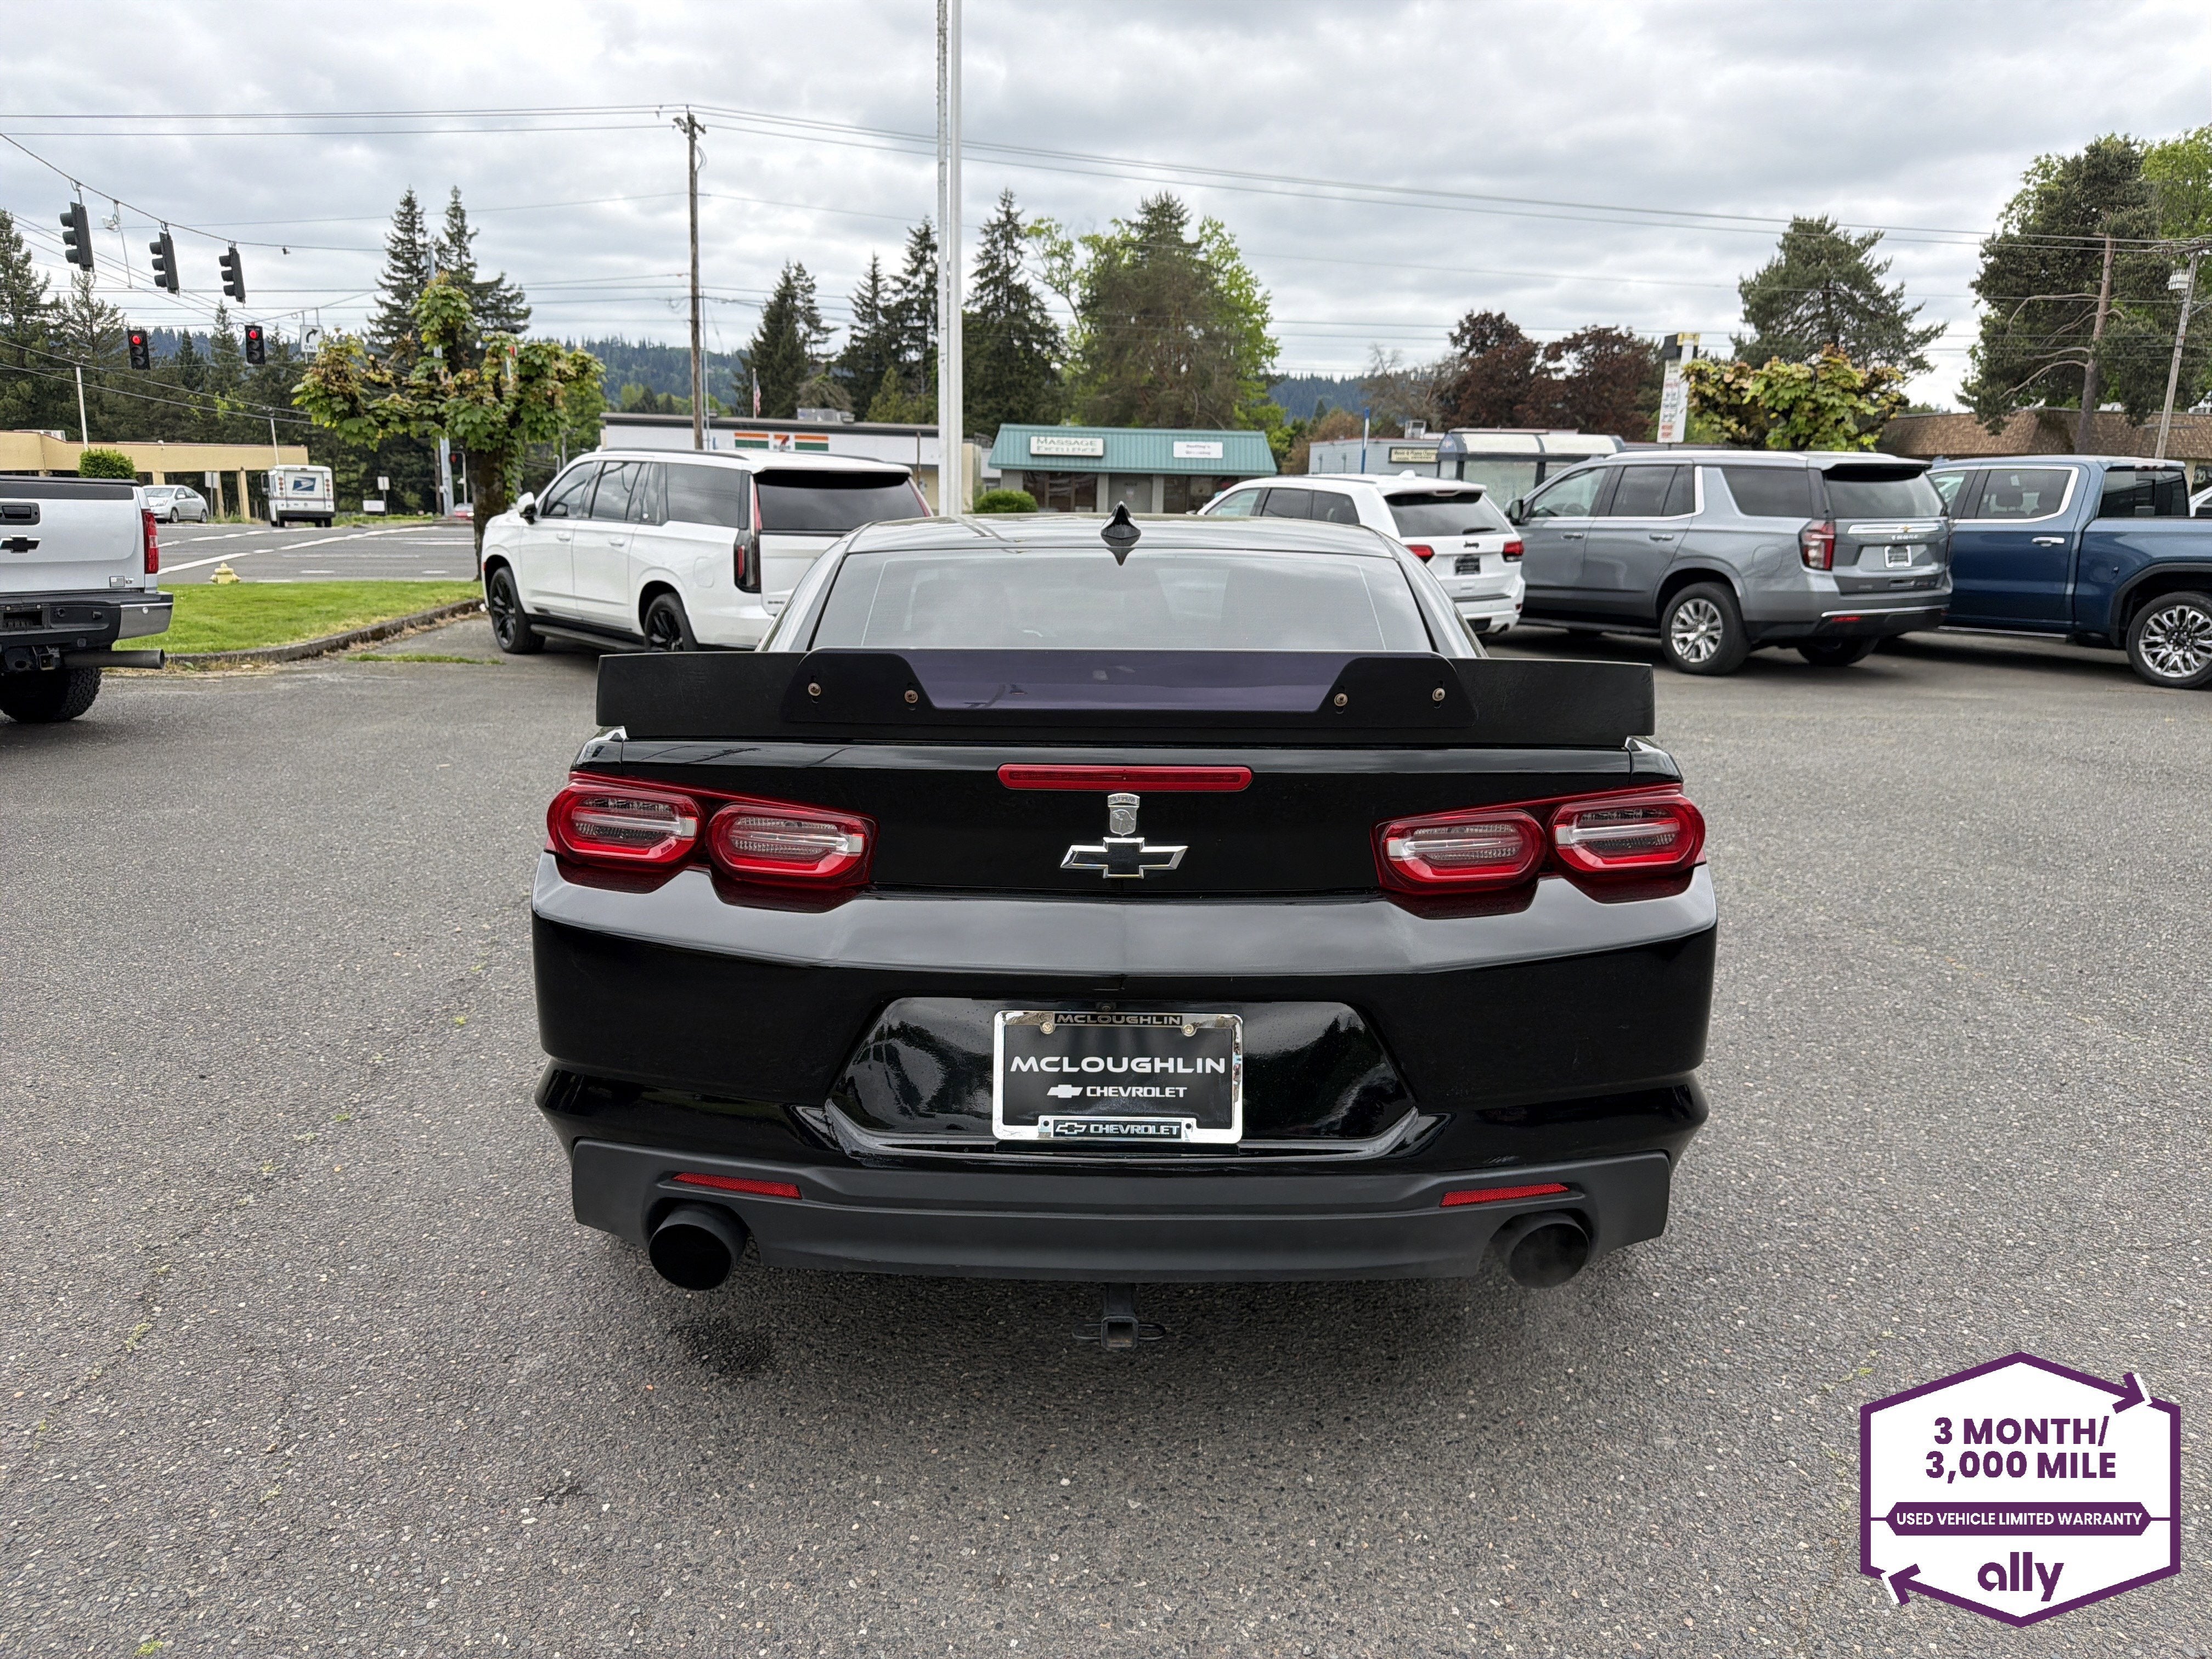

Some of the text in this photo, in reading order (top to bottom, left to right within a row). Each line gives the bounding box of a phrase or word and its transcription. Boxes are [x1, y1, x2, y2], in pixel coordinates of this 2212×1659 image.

[1036, 436, 1097, 446] MASSAGE
[1057, 1014, 1182, 1025] MCLOUGHLIN
[1011, 1056, 1225, 1074] MCLOUGHLIN
[1086, 1086, 1188, 1098] CHEVROLET
[1090, 1124, 1180, 1135] CHEVROLET
